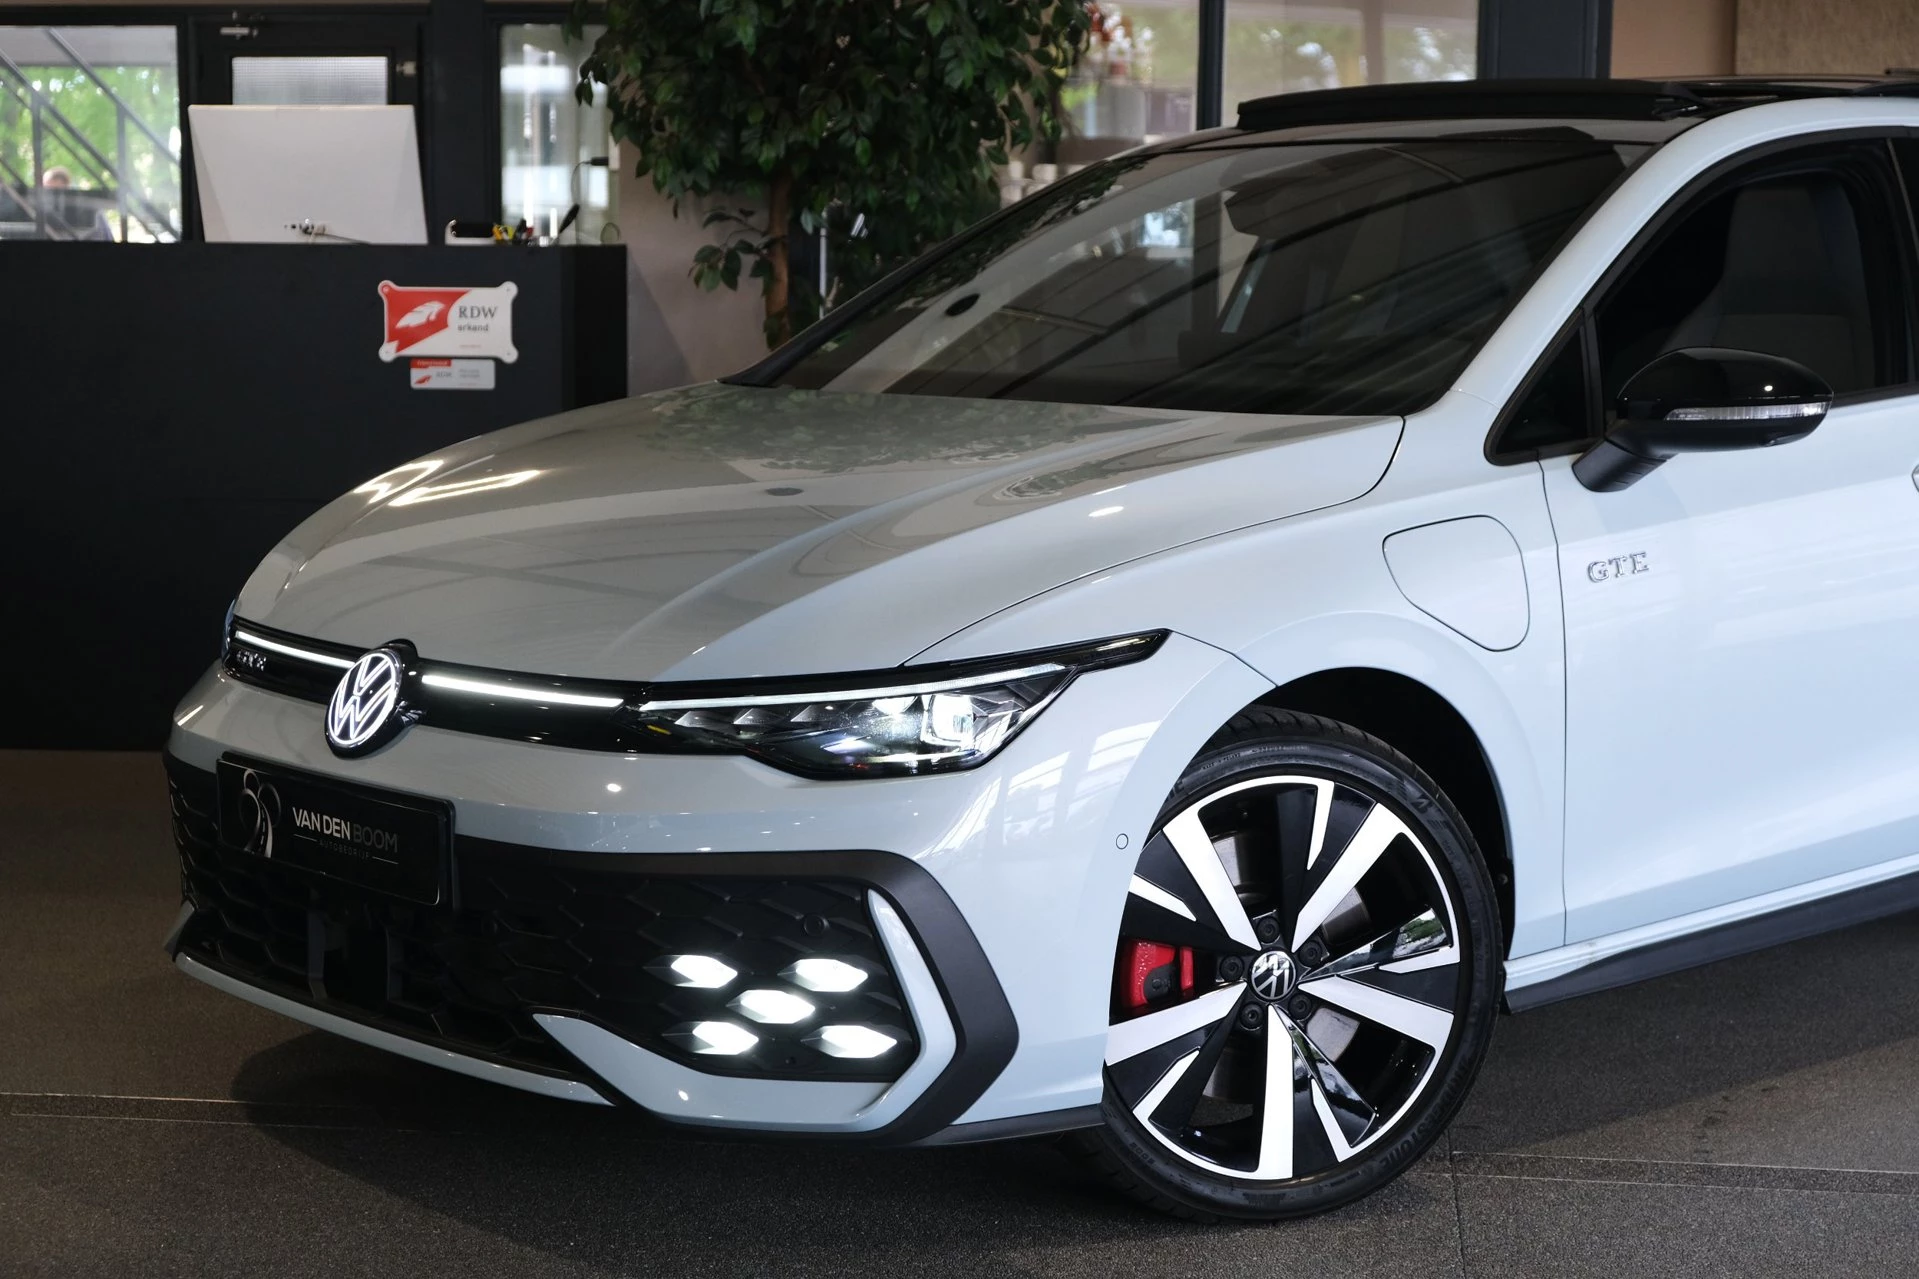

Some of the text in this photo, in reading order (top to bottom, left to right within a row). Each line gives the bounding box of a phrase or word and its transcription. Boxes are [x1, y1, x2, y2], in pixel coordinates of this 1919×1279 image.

[458, 305, 498, 319] RDW
[1587, 551, 1649, 583] GTE
[292, 806, 398, 853] VAN DEN BOOM
